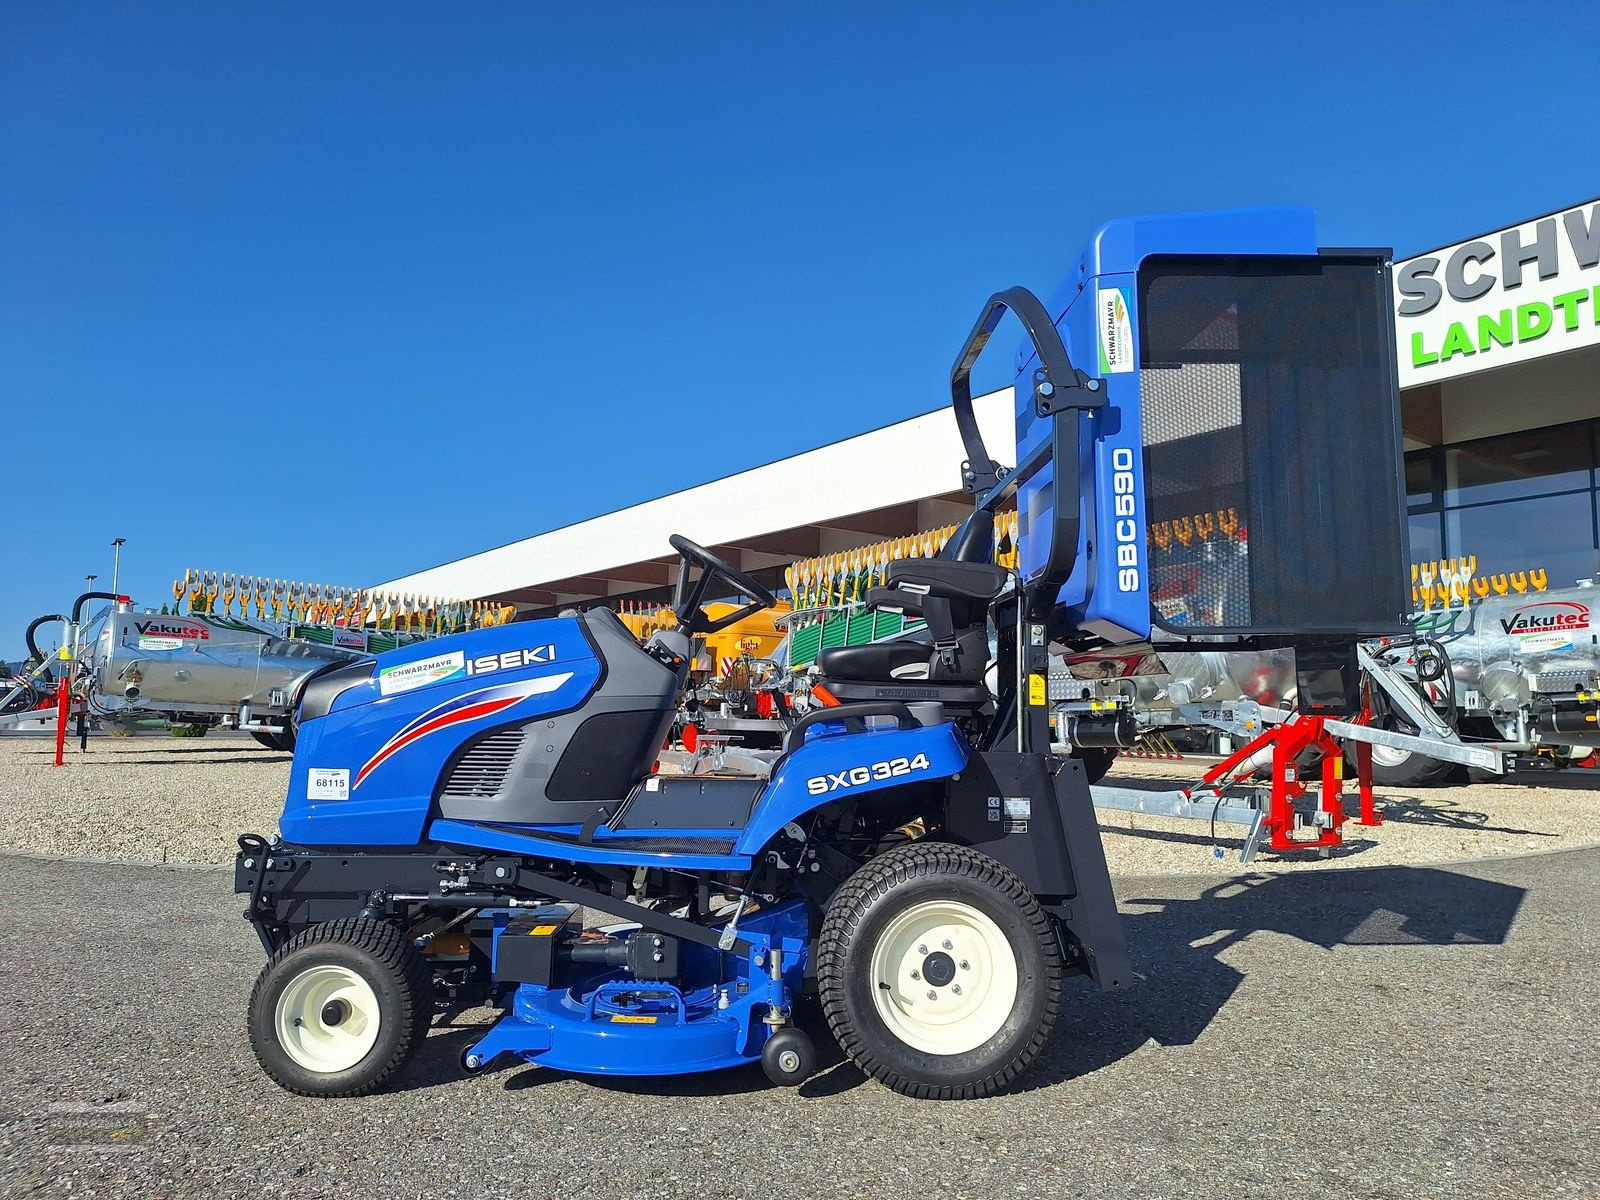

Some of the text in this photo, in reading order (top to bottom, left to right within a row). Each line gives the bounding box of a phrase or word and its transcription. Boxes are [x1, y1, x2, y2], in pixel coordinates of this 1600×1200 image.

[1107, 301, 1116, 365] SCHWARZMAYR
[1411, 285, 1600, 369] LANDT
[1113, 448, 1139, 592] SBC590
[134, 620, 209, 636] Vakutec
[1500, 612, 1590, 635] Vakutec
[387, 659, 452, 680] SCHWARZMAYR
[466, 644, 556, 676] ISEKI
[316, 778, 345, 788] 68115
